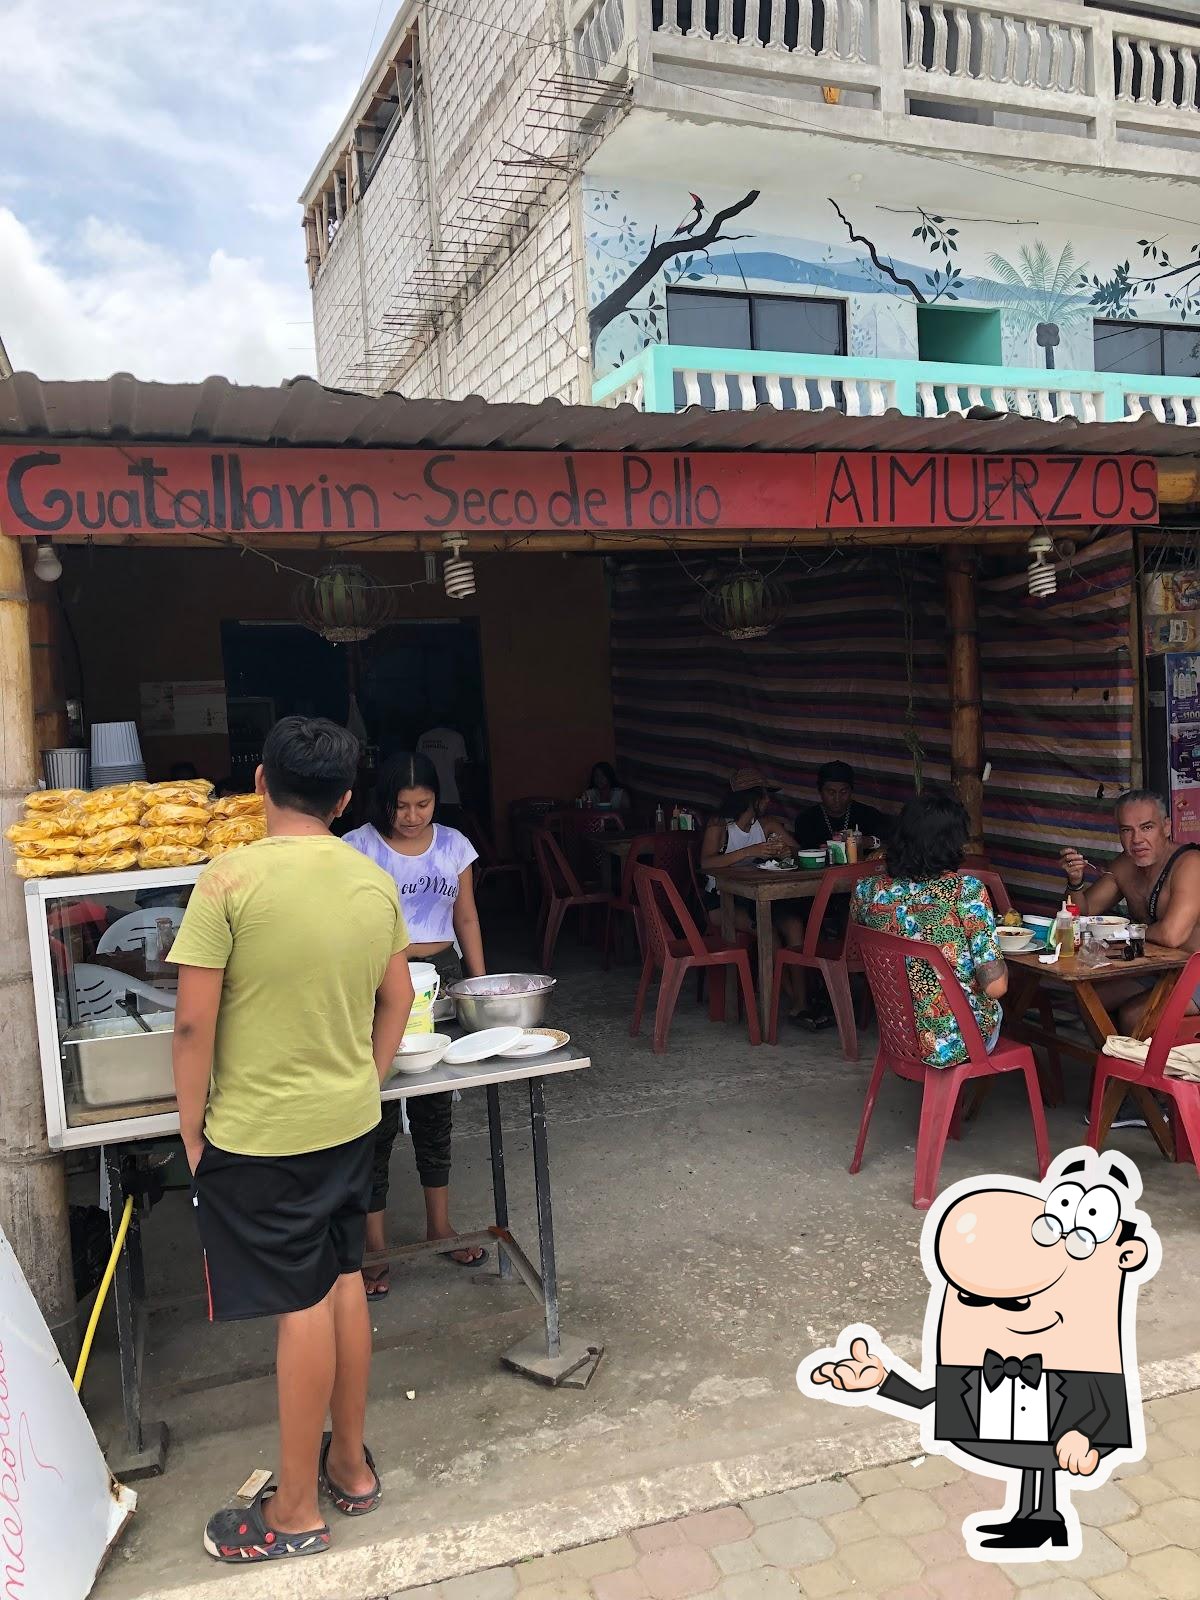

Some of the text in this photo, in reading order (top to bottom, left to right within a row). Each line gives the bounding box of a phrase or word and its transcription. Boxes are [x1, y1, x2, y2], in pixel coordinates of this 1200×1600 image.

[7, 450, 722, 532] Guatallarin Seco de Pollo
